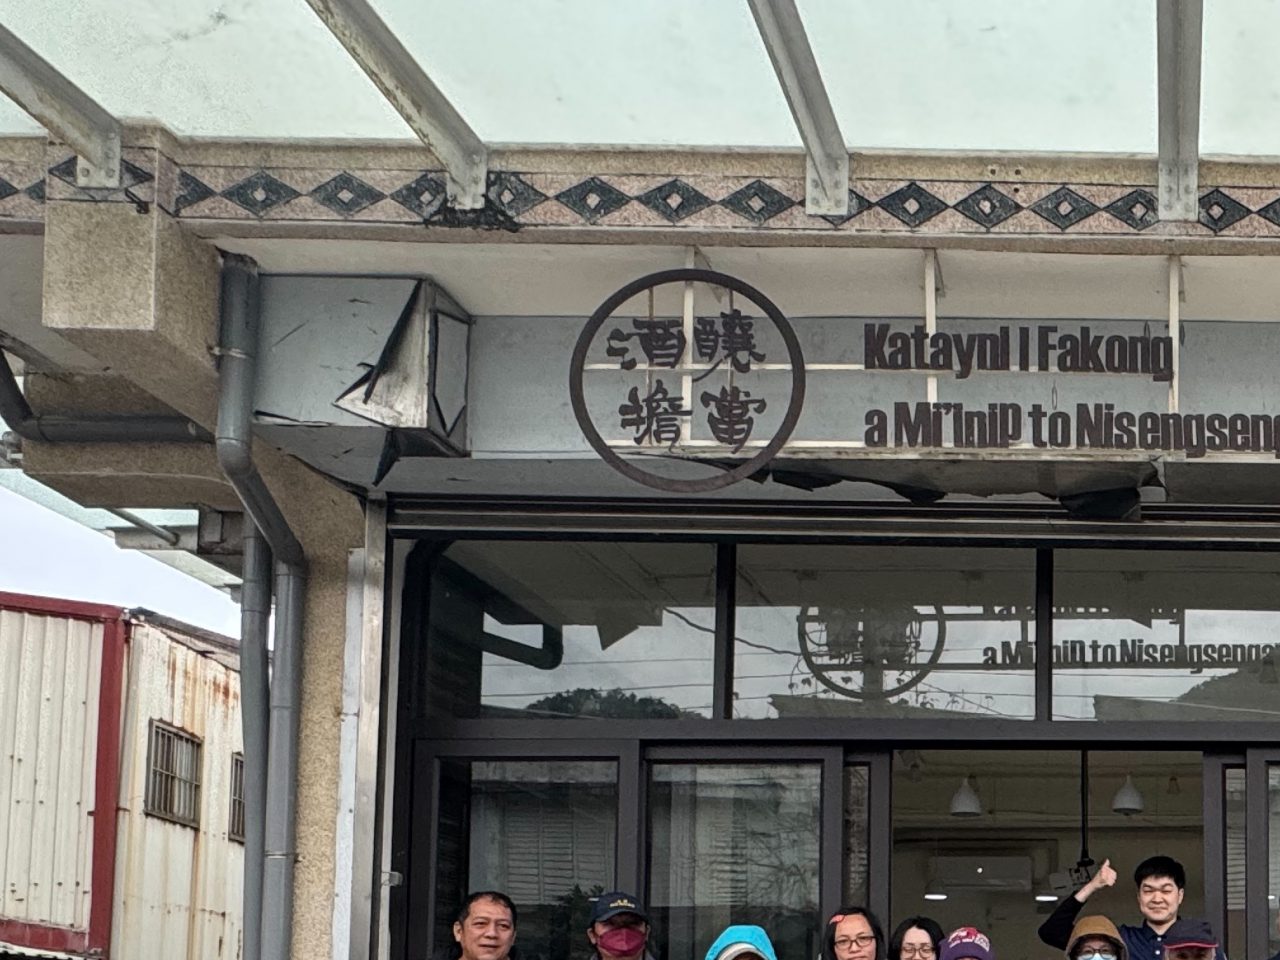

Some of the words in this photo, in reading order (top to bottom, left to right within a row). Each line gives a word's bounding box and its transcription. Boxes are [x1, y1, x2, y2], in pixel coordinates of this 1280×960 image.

[1038, 325, 1175, 382] Fakong
[864, 408, 888, 448] a
[1028, 403, 1071, 449] to
